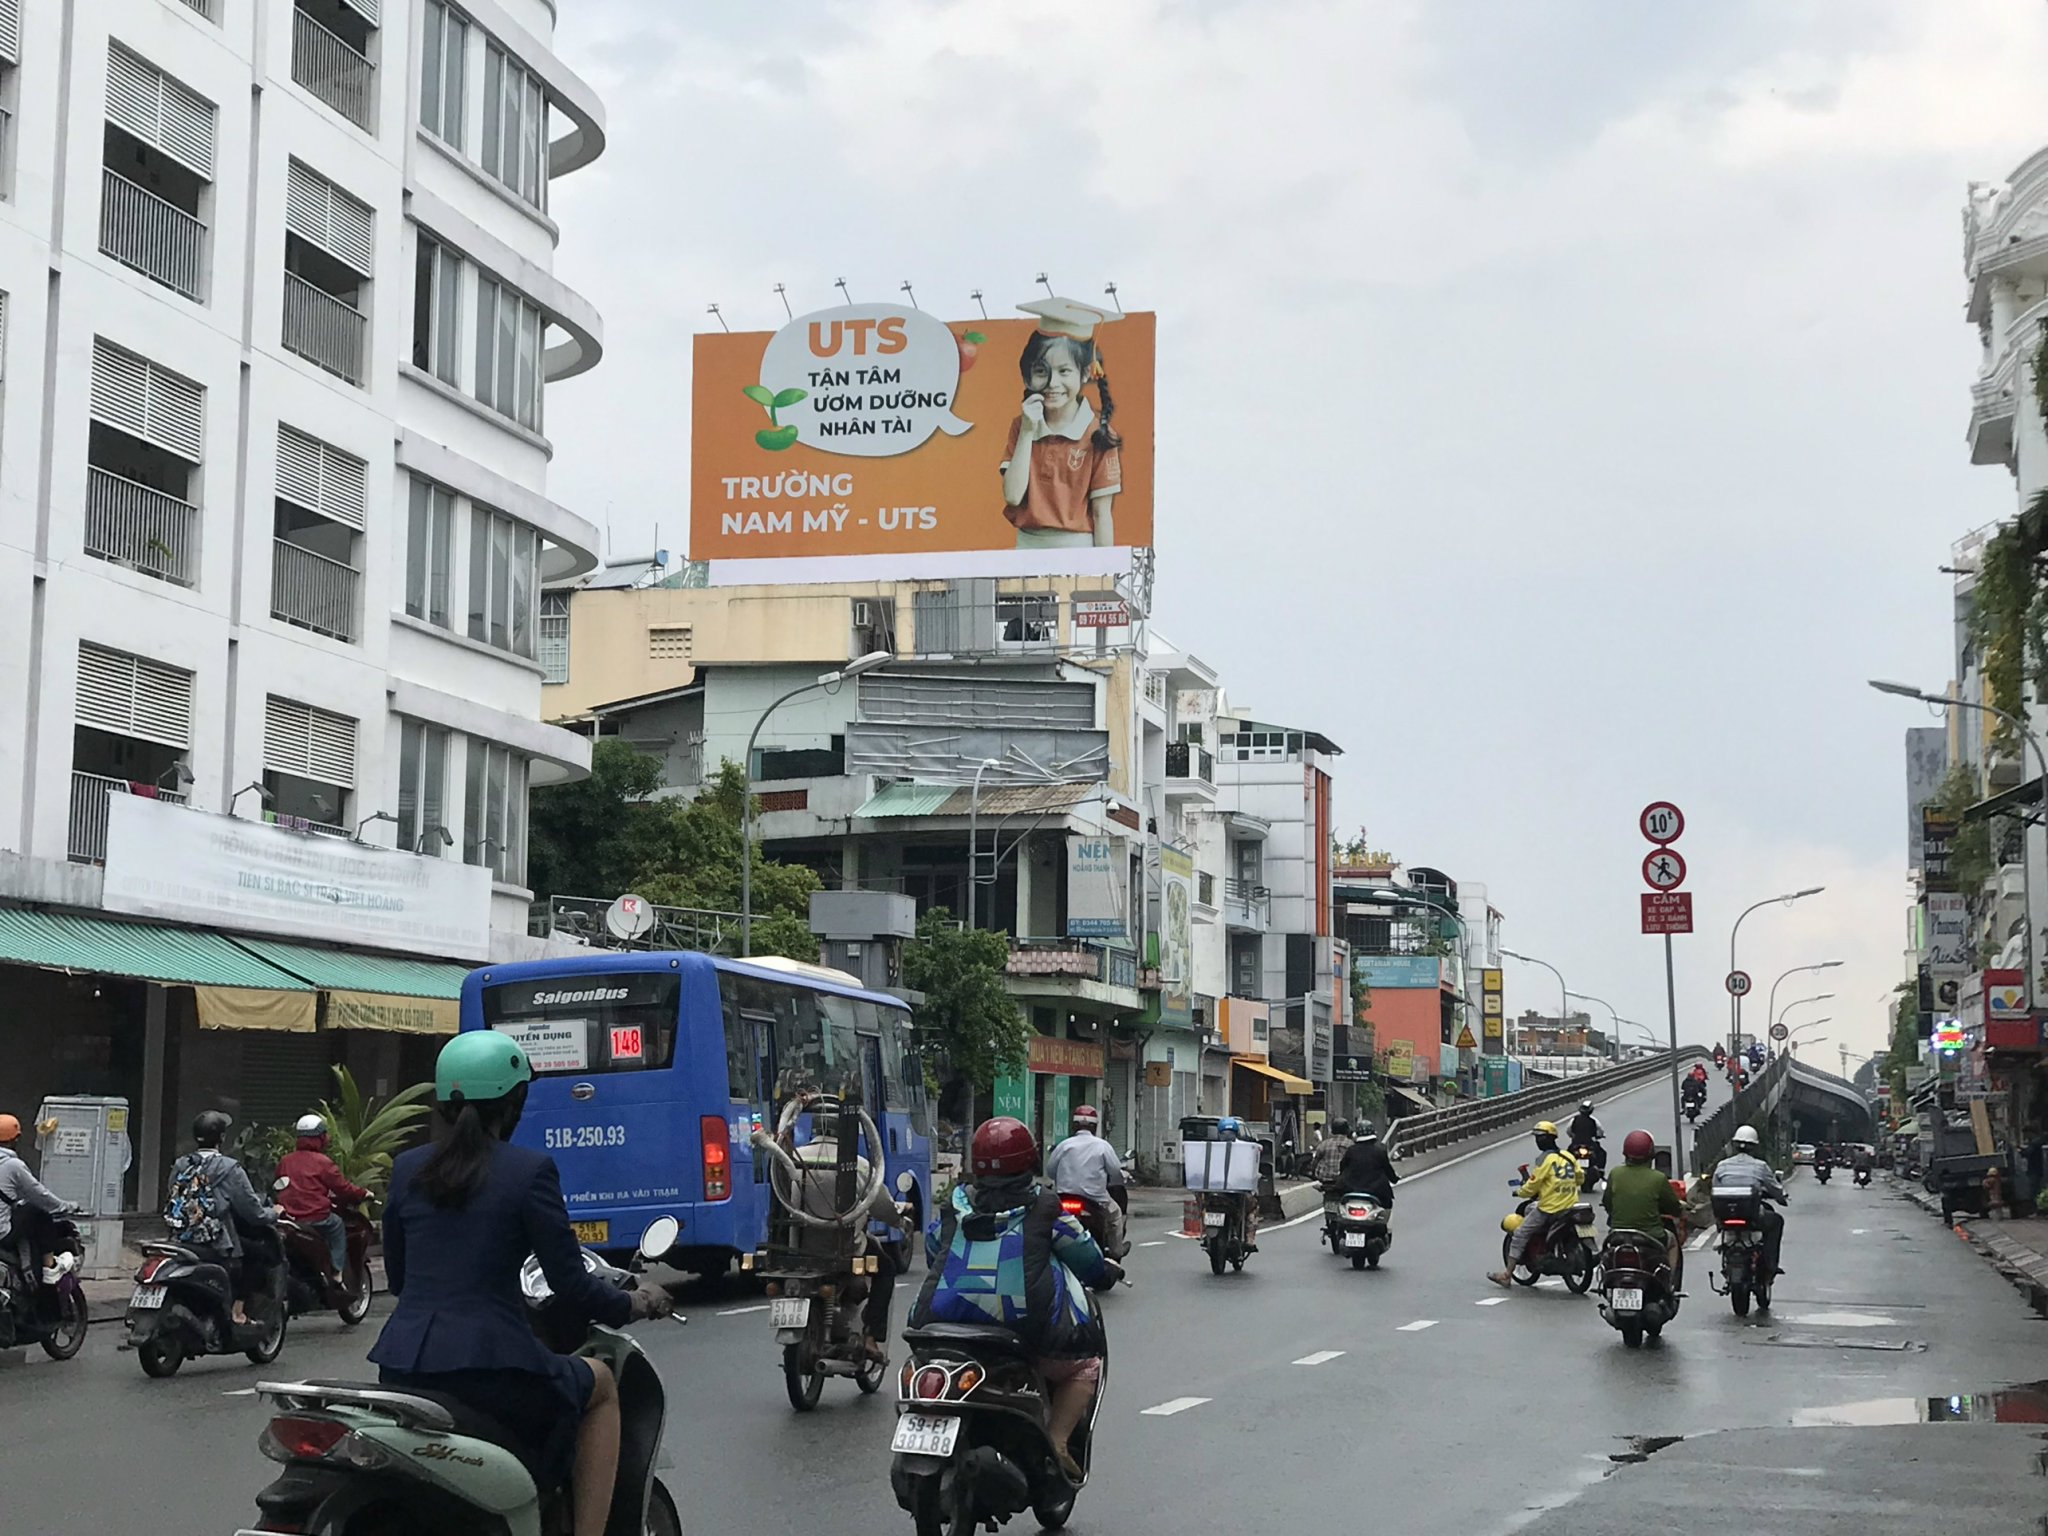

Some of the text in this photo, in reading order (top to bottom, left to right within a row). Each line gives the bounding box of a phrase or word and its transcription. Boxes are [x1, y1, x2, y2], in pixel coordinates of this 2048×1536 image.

[808, 316, 908, 358] UTS
[808, 365, 901, 391] TẬN TÂM
[813, 389, 948, 412] ƯƠM DƯỠNG
[819, 415, 912, 436] NHÂN TÀI
[721, 469, 853, 500] TRƯỜNG
[721, 511, 792, 535] NAM
[802, 503, 850, 533] MỸ
[878, 506, 938, 530] UTS
[532, 987, 629, 1006] SaigonBus
[612, 1028, 640, 1057] 148
[544, 1125, 625, 1149] 51B-250.93
[617, 1189, 629, 1199] RA
[907, 1416, 949, 1435] 59-E1
